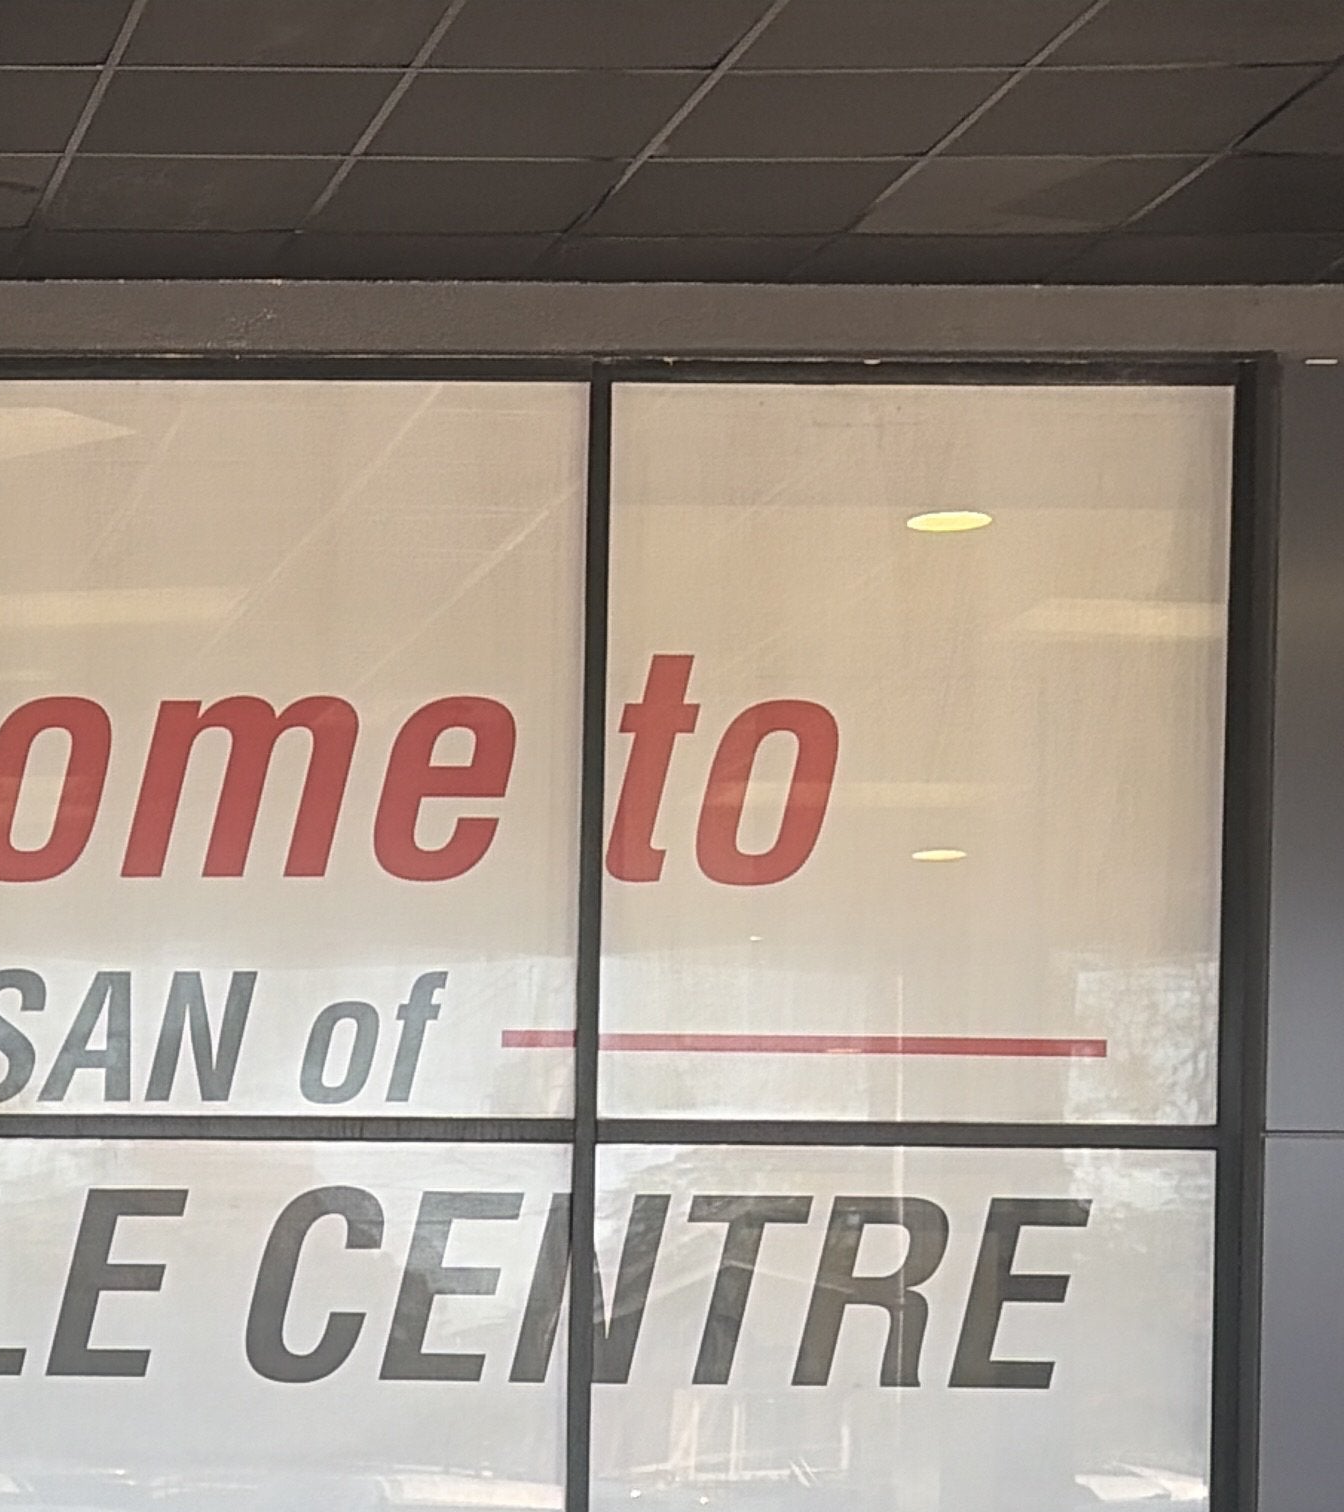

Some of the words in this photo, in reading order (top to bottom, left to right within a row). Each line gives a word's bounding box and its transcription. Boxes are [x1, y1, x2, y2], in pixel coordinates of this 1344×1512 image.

[603, 653, 841, 888] to
[298, 968, 450, 1107] of
[244, 1184, 1094, 1390] CENTRE
